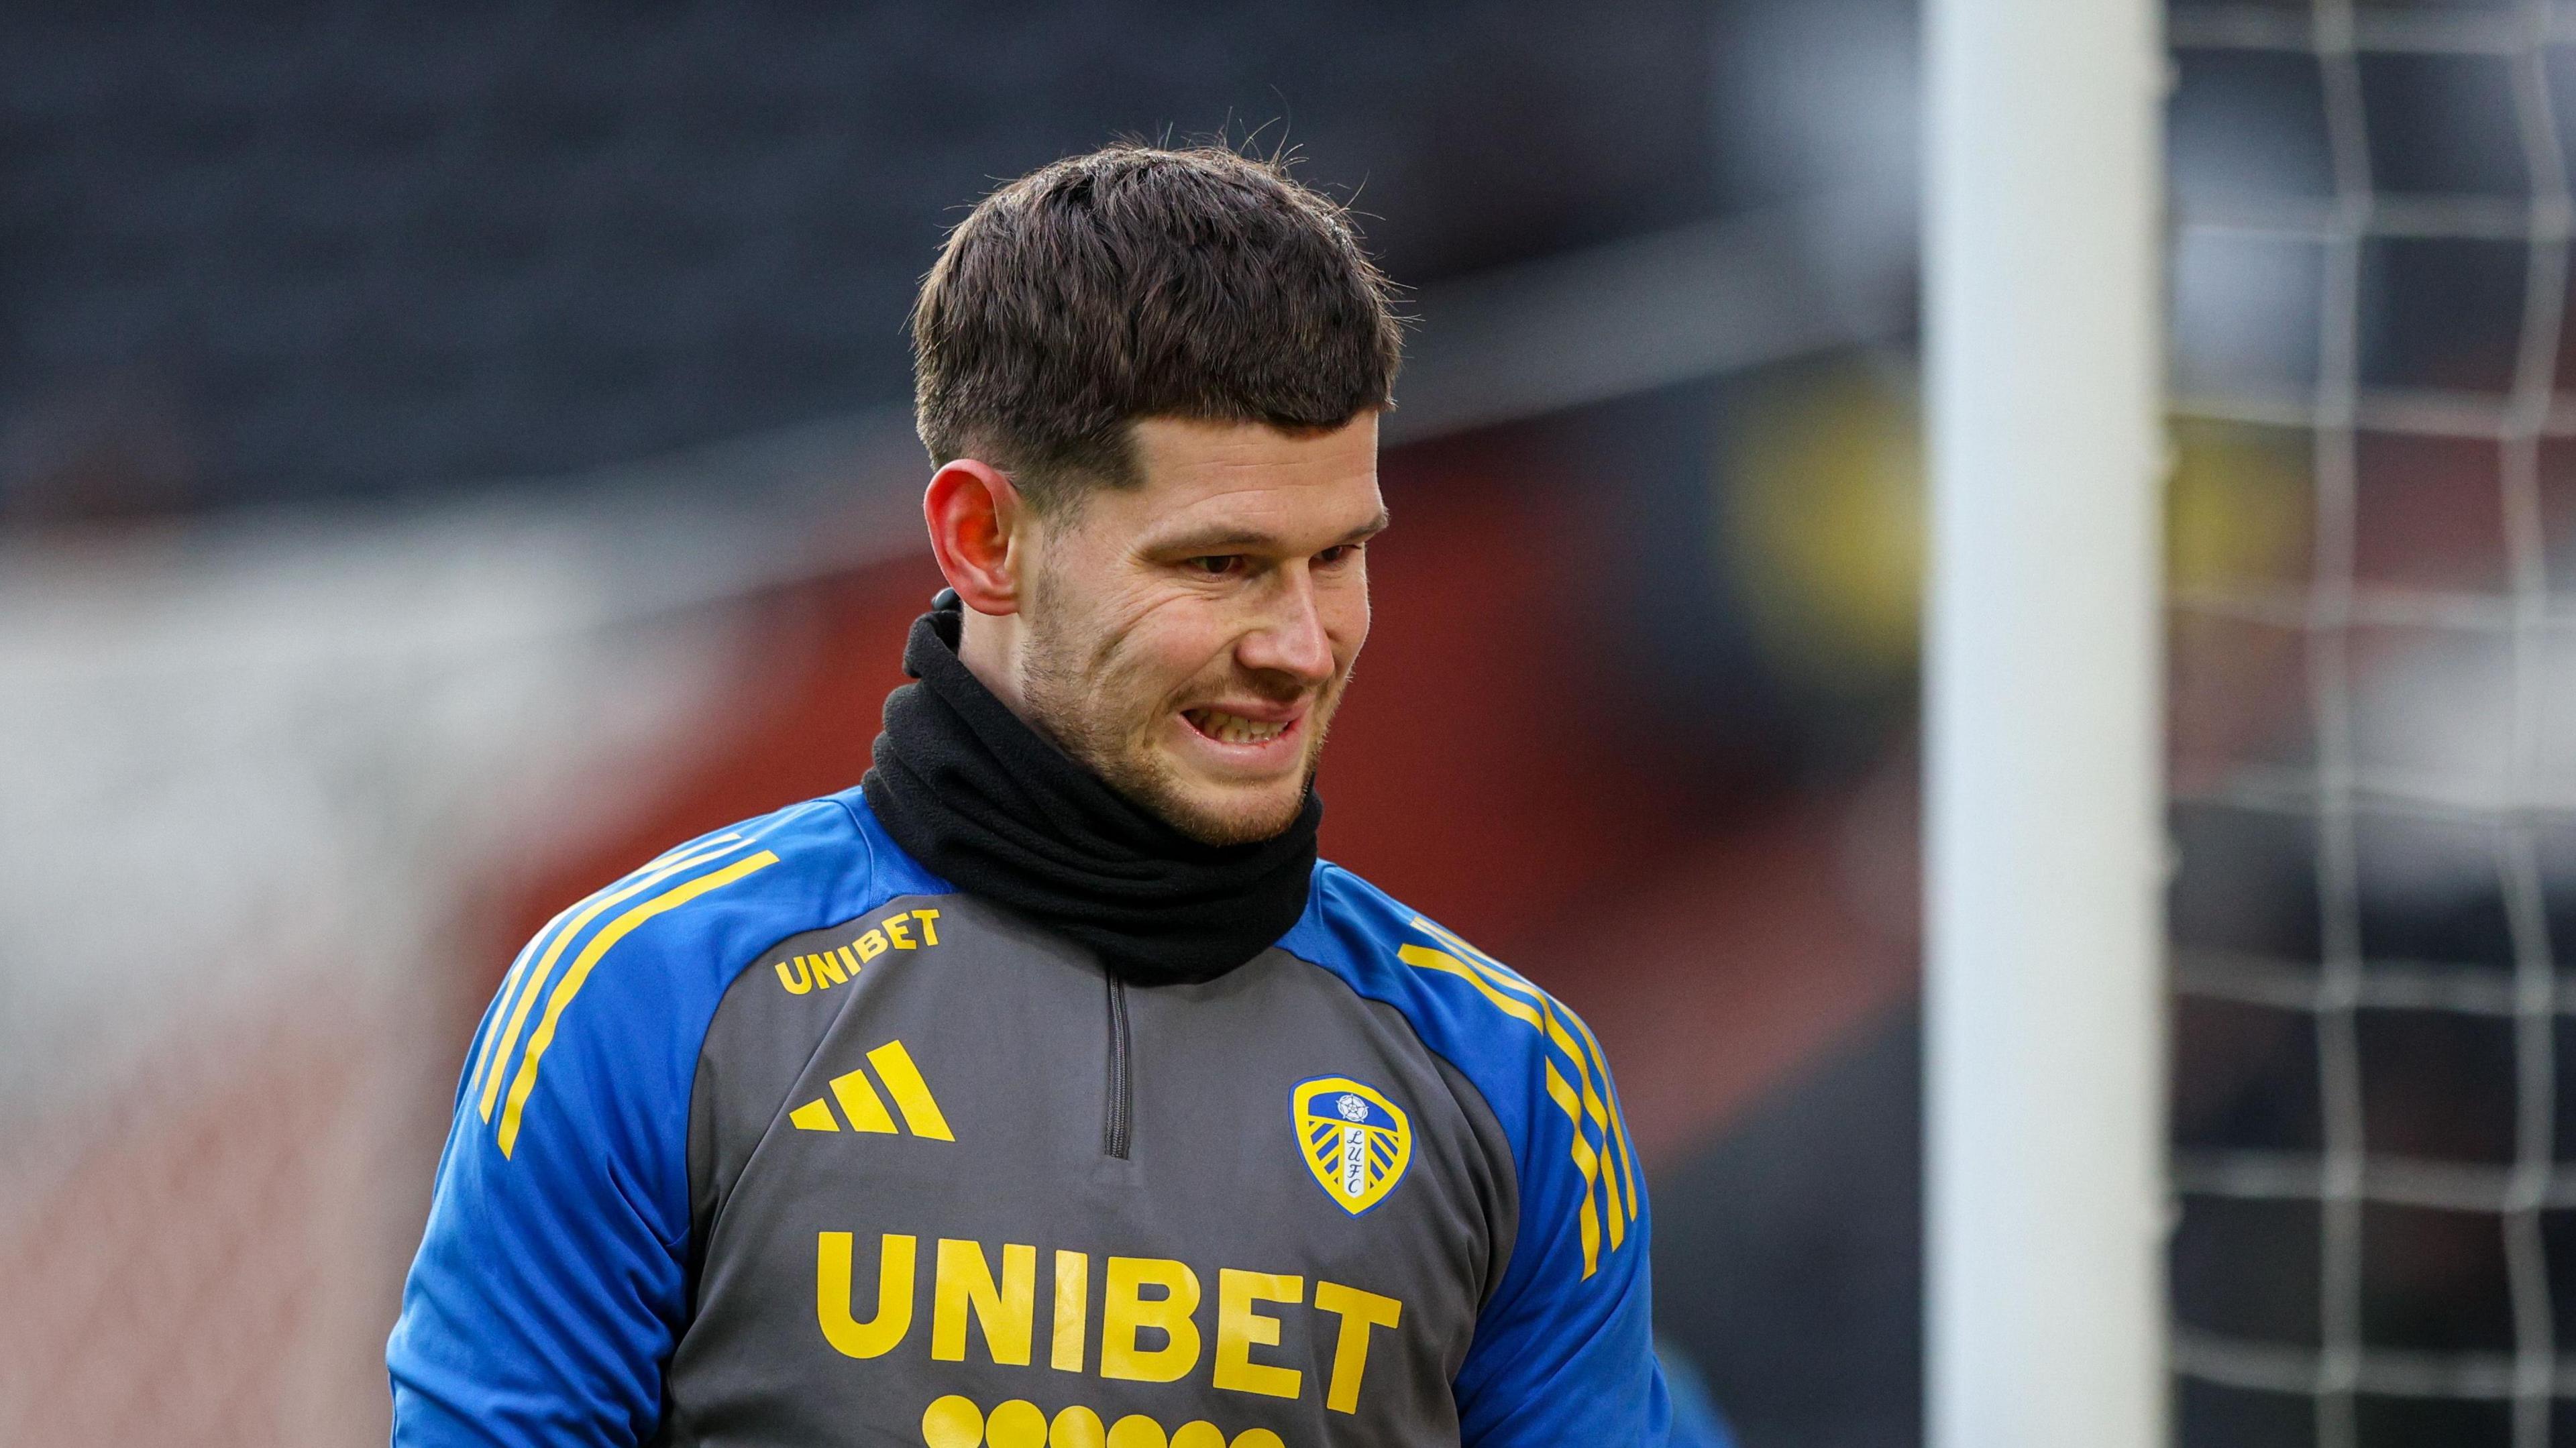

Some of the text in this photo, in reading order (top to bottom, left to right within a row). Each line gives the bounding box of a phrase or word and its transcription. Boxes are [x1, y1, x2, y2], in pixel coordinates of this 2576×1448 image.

[774, 909, 940, 995] UNIBET
[1346, 1130, 1363, 1194] LUFC
[816, 1231, 1403, 1414] UNIBET
